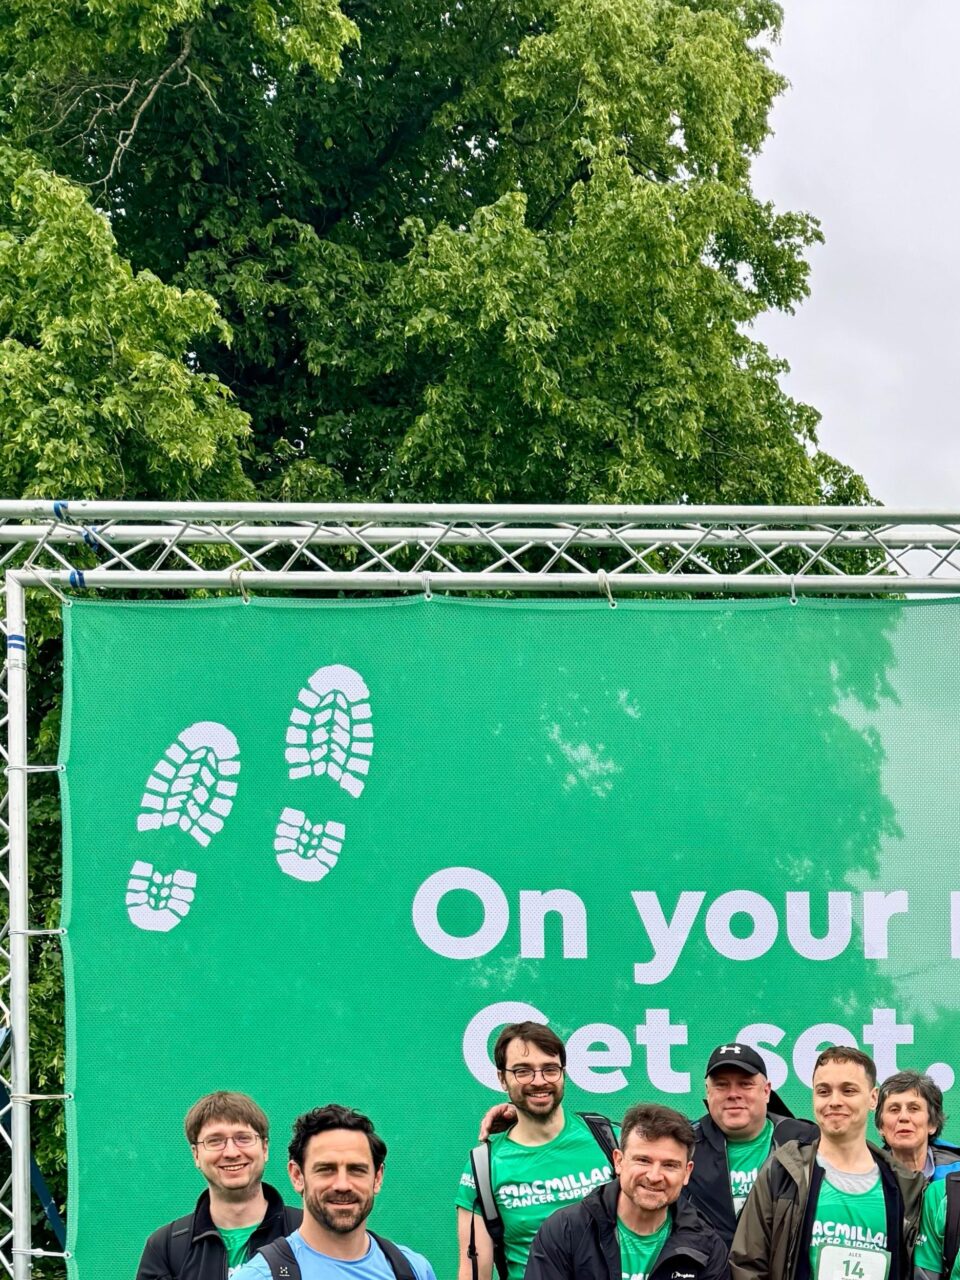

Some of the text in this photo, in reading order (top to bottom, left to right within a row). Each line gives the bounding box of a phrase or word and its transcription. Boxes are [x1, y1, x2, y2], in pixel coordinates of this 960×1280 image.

[412, 867, 587, 960] On
[632, 890, 909, 984] your
[463, 1002, 691, 1093] Get
[735, 1008, 956, 1092] set.
[499, 1165, 612, 1199] MACMILLAN
[503, 1184, 598, 1209] CANCER SUPPO
[812, 1219, 888, 1248] ACMILLA
[842, 1260, 865, 1279] 14
